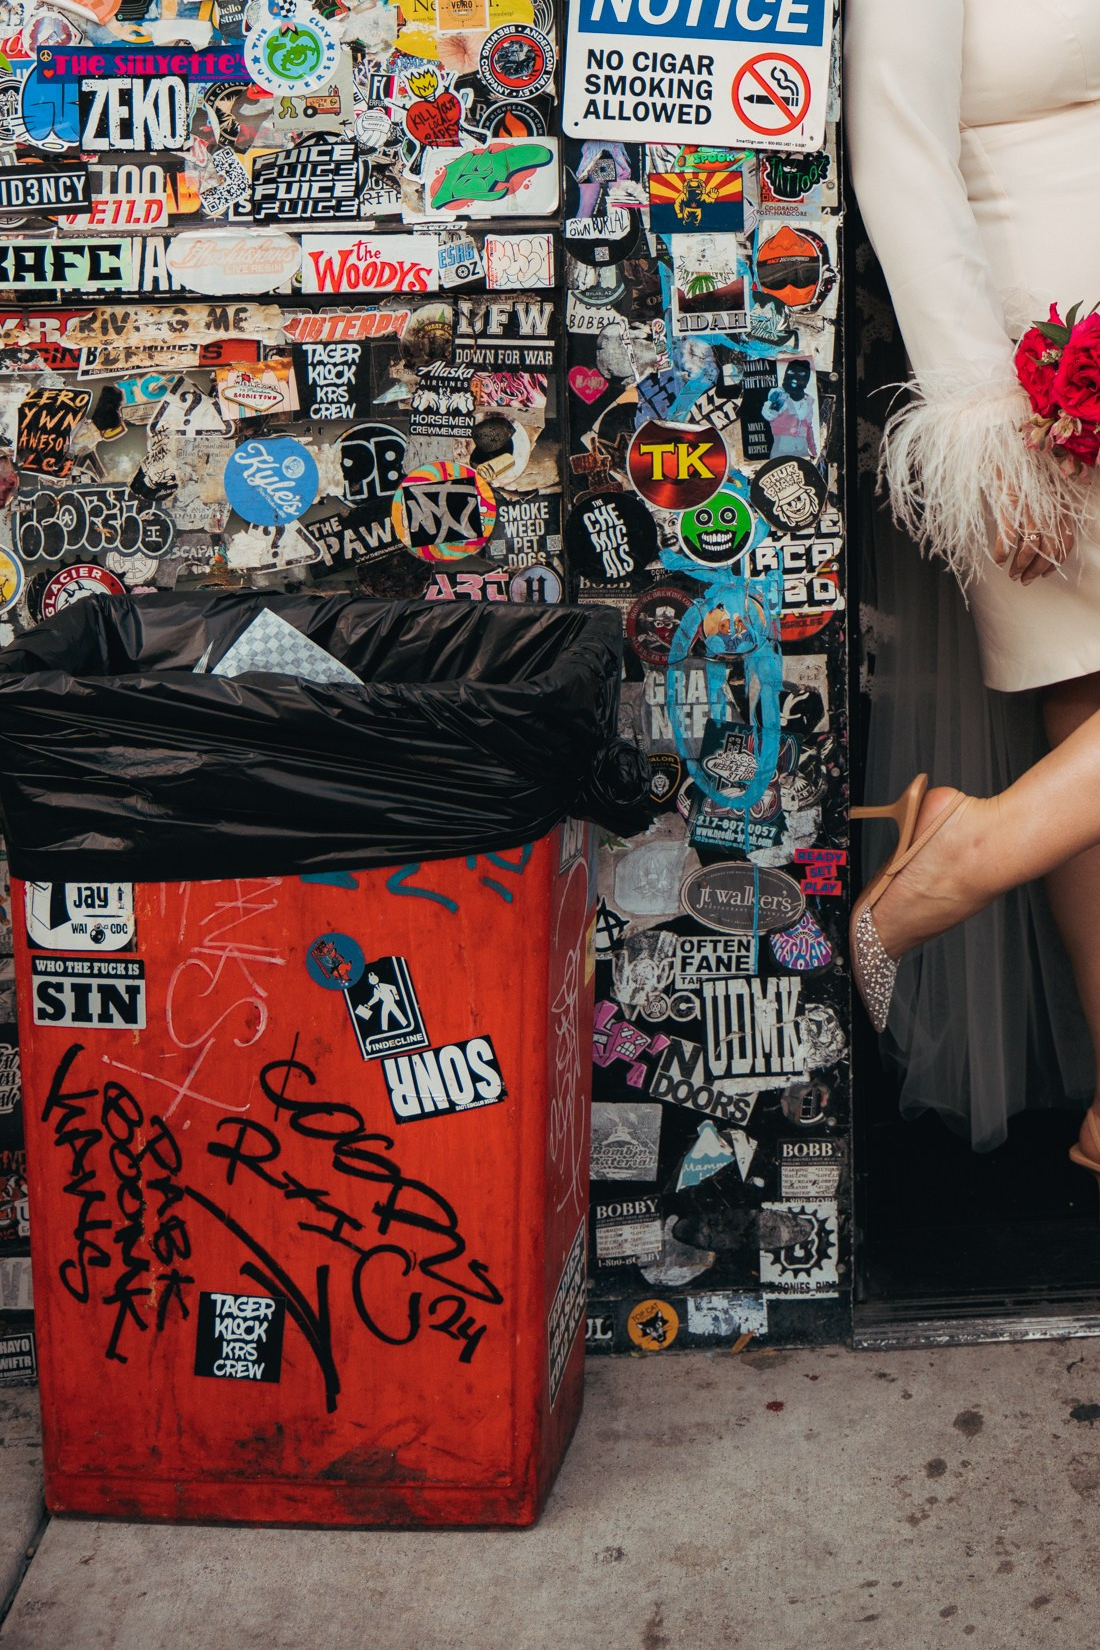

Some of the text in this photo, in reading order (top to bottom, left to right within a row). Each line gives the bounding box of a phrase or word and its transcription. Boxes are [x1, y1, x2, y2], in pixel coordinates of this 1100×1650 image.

[587, 49, 714, 75] NO CIGAR
[584, 75, 712, 99] SMOKING
[583, 100, 712, 125] ALLOWED
[355, 240, 380, 260] the
[308, 345, 360, 364] TAGER
[456, 350, 552, 365] DOWN FOR WAR
[316, 386, 348, 403] KRS
[310, 403, 355, 418] CREW
[500, 503, 548, 520] SMOKE
[505, 518, 545, 536] WEED
[514, 537, 538, 552] PET
[508, 553, 547, 567] DOGS
[71, 923, 128, 934] WAI CDC
[681, 938, 751, 953] OFTEN
[36, 961, 139, 975] WHO THE FUCK IS
[681, 957, 749, 973] FANE
[37, 983, 144, 1024] SIN
